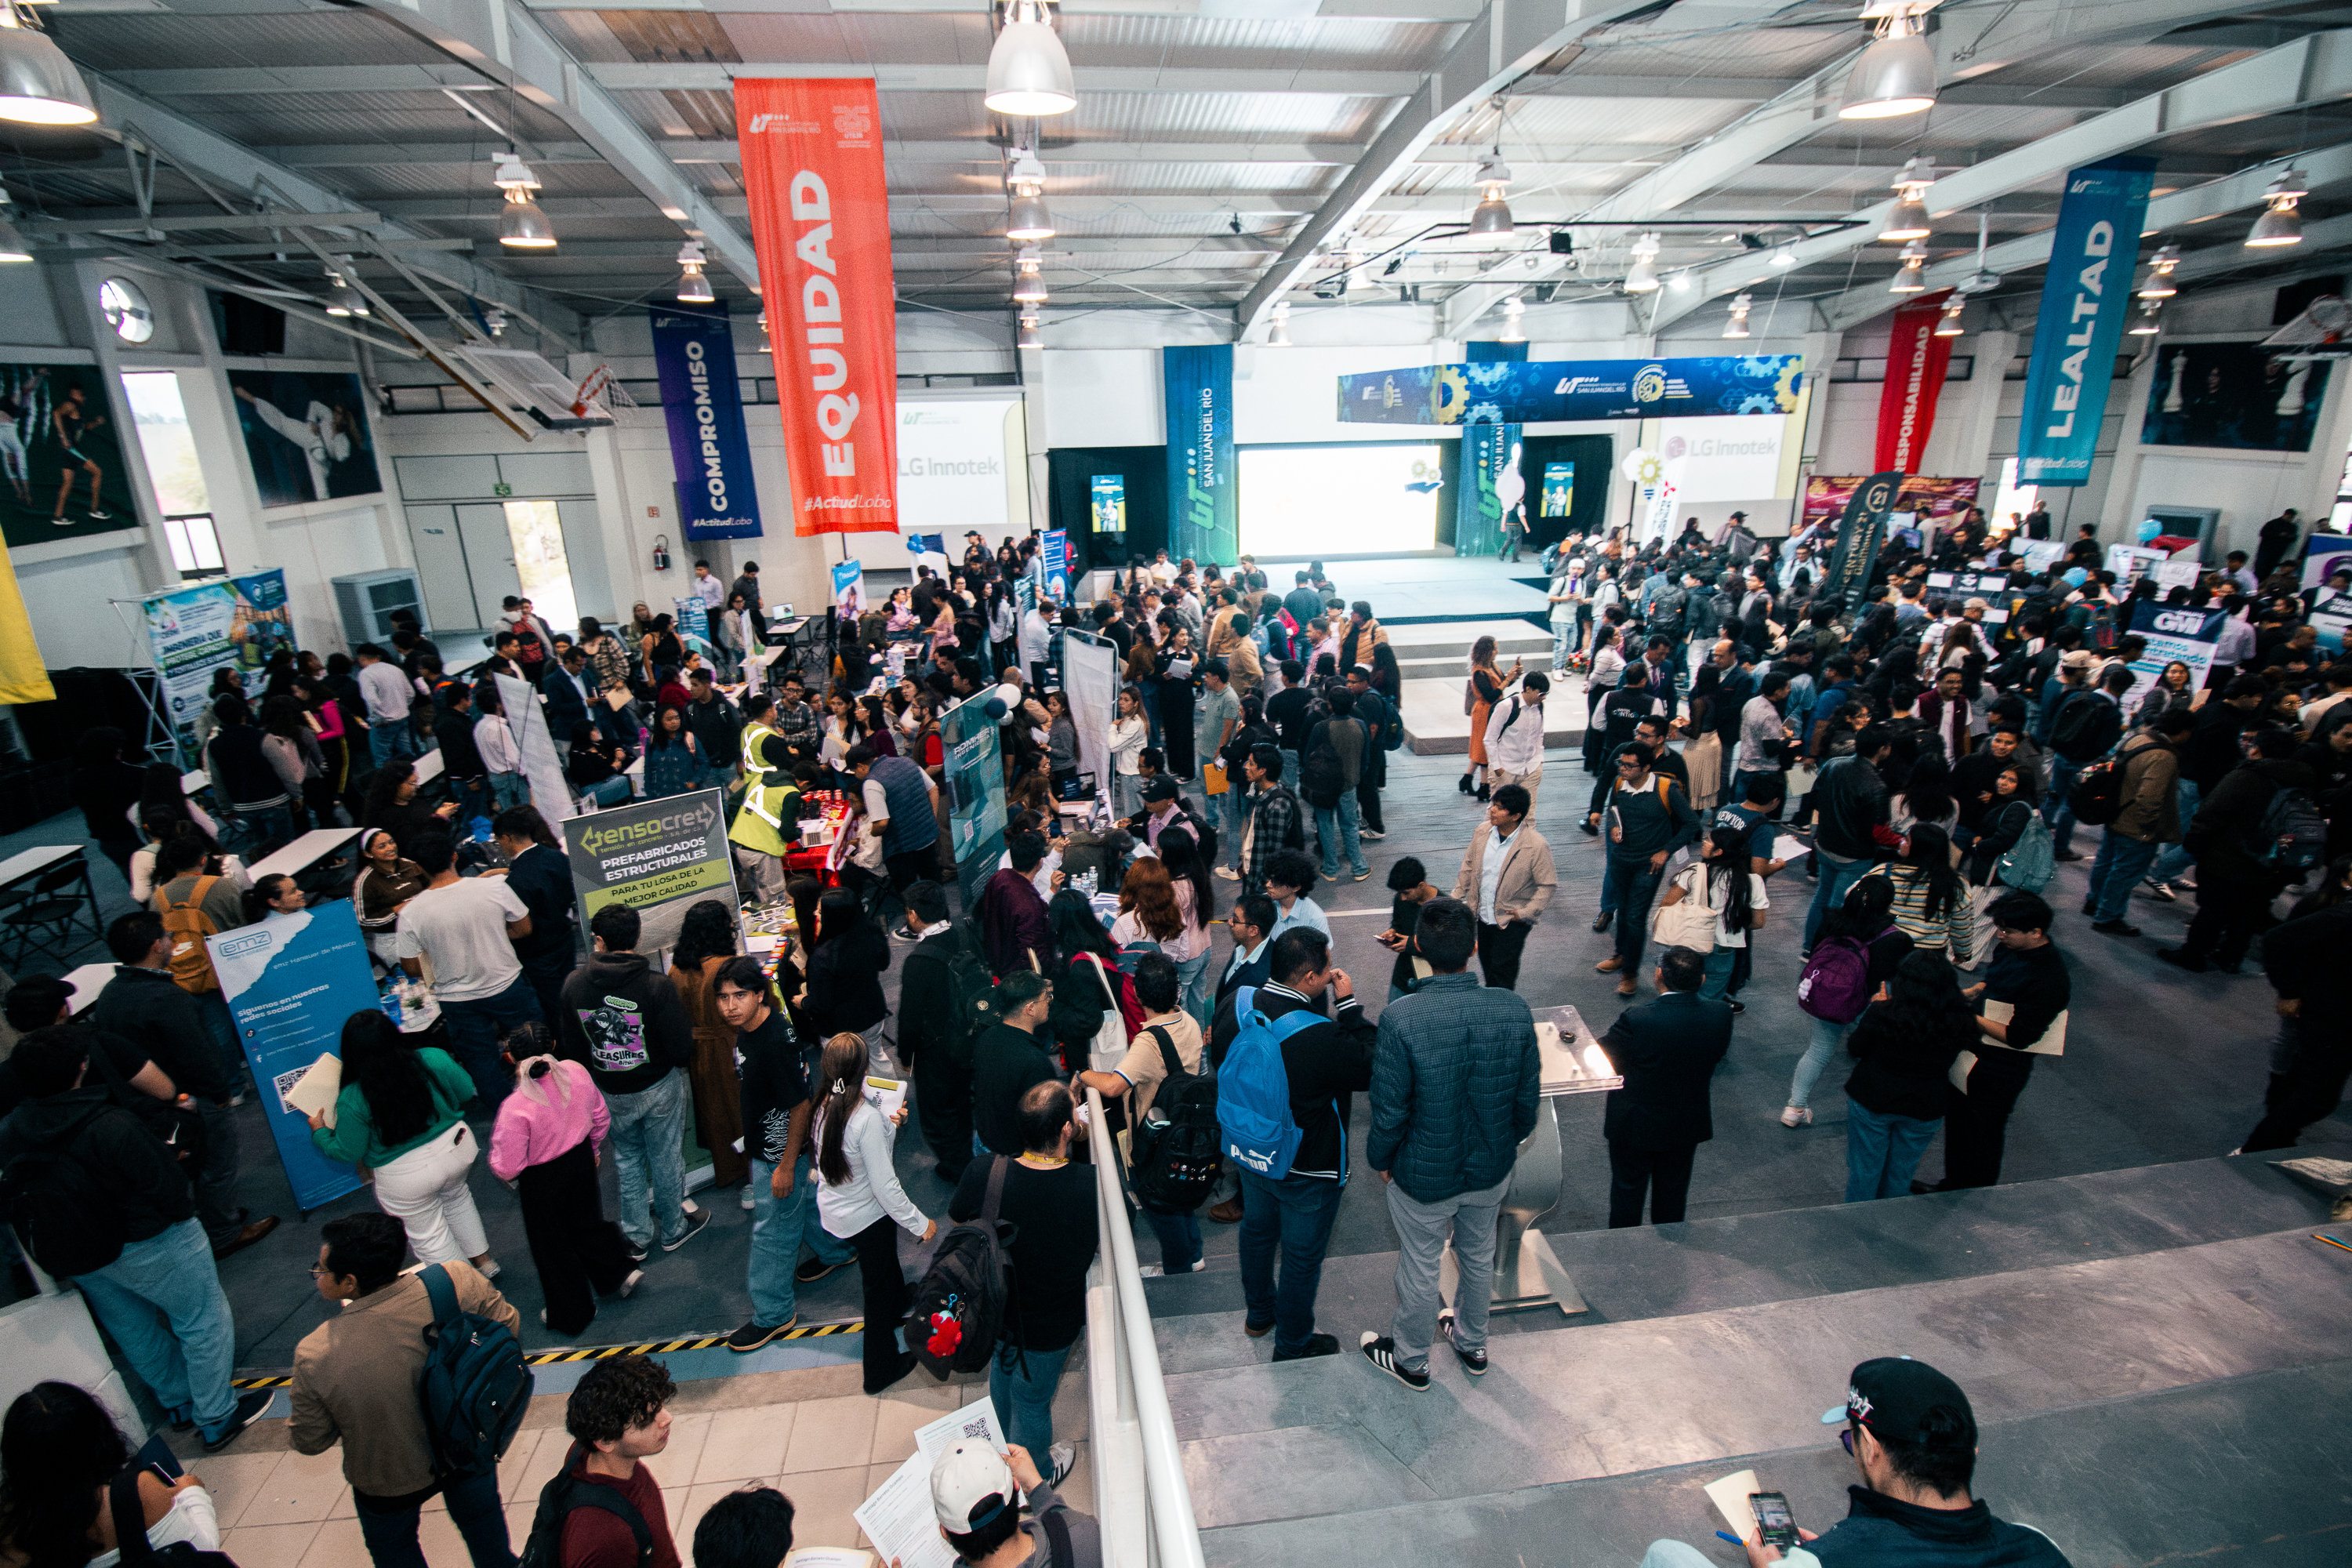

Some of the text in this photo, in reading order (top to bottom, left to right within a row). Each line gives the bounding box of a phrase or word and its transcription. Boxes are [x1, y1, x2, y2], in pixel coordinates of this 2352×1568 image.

[790, 169, 860, 477] EQUIDAD
[2045, 220, 2114, 438] LEALTAD
[1893, 325, 1930, 473] RESPONSABILIDAD
[685, 340, 728, 512] COMPROMISO
[1202, 387, 1214, 488] SAN JUAN DEL RÍO
[1690, 437, 1777, 457] LG Innotek
[896, 456, 999, 477] LG Innotek
[2143, 647, 2208, 664] ntratando
[2147, 637, 2189, 652] tamos
[601, 837, 706, 869] PREFABRICADOS
[637, 834, 663, 846] concreto
[604, 848, 708, 881] ESTRUCTURALES
[612, 884, 639, 897] PARA
[640, 881, 653, 890] TU
[655, 874, 677, 886] LOSA
[694, 866, 706, 875] LA
[624, 880, 698, 906] MEJOR CALIDAD
[223, 933, 269, 953] emz
[279, 996, 291, 1005] en
[292, 983, 330, 1001] nuestras
[240, 1000, 303, 1025] redes sociales
[862, 1498, 879, 1516] Santiago
[876, 1487, 891, 1501] Barreto
[887, 1474, 905, 1490] Ocampo
